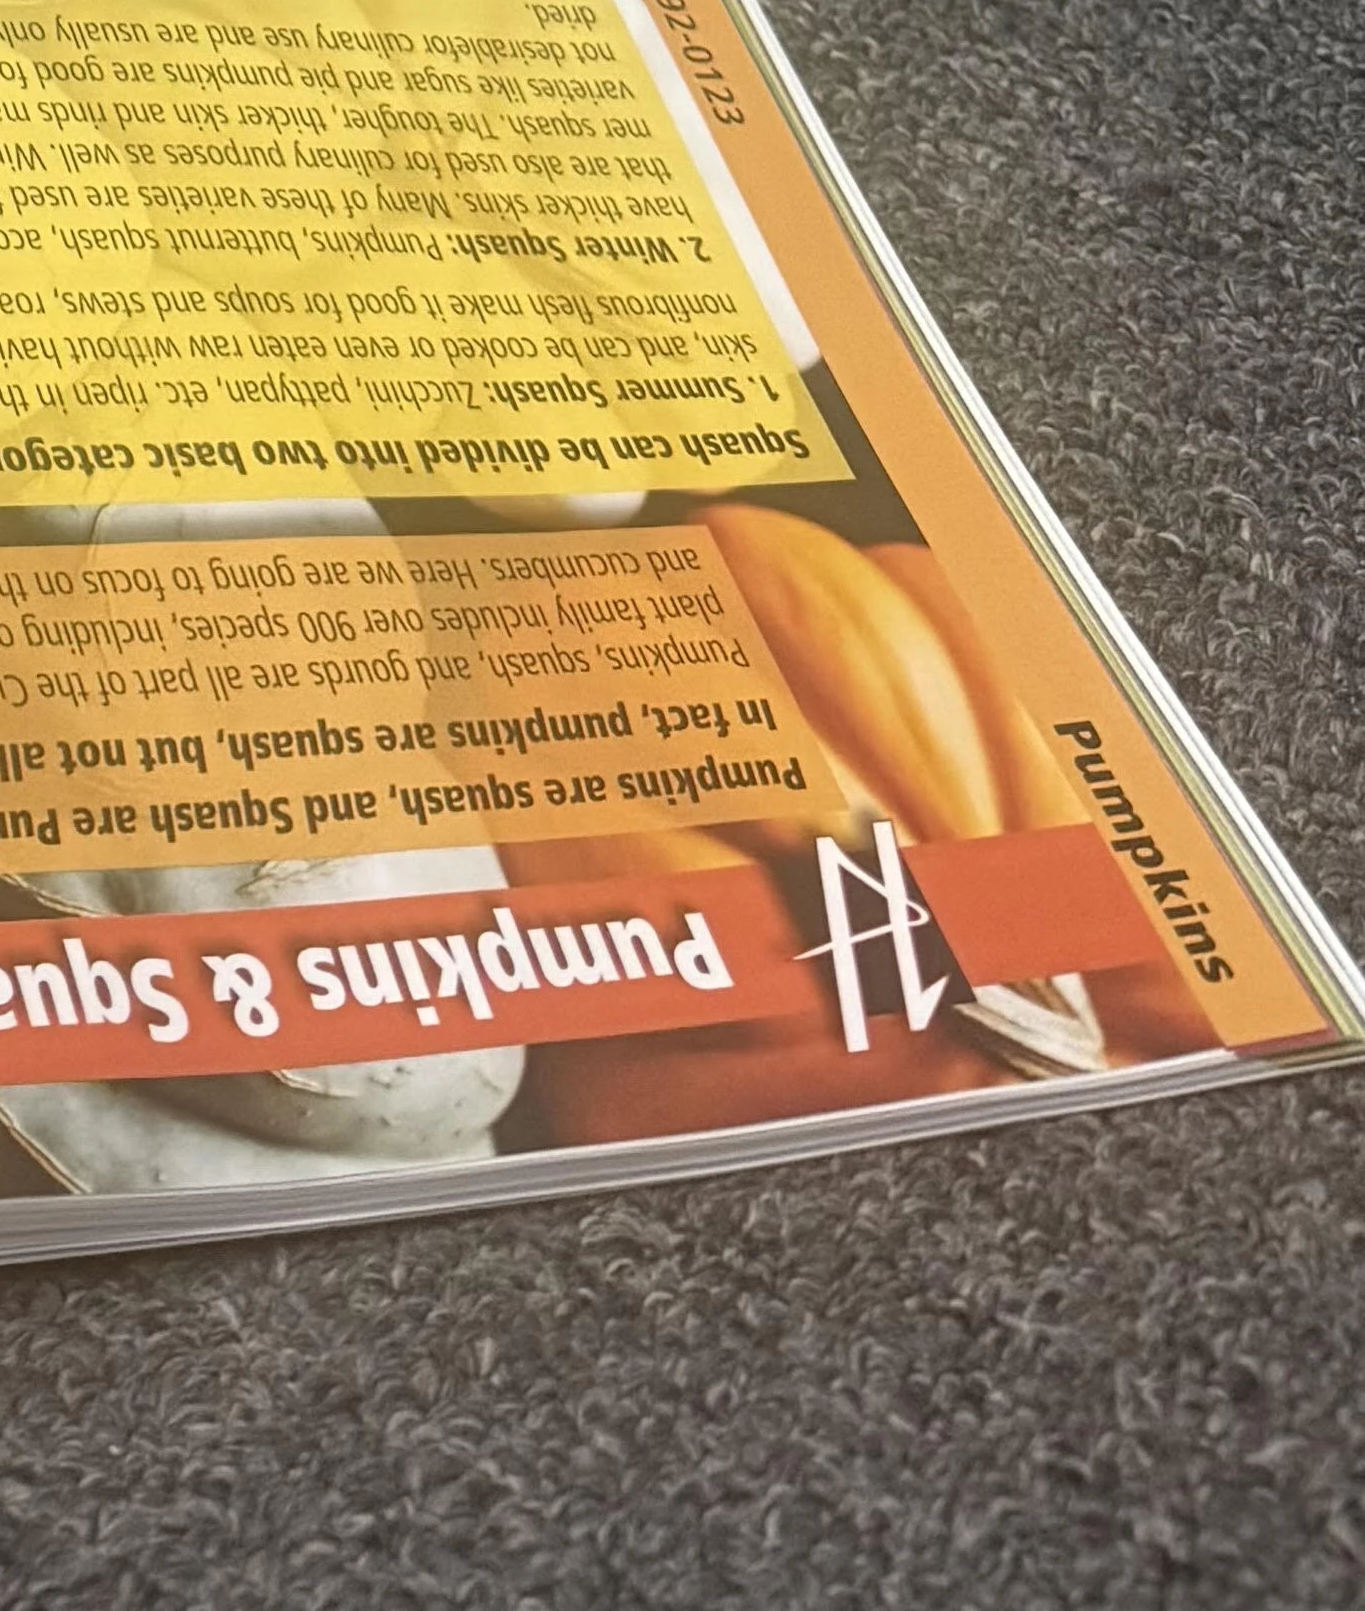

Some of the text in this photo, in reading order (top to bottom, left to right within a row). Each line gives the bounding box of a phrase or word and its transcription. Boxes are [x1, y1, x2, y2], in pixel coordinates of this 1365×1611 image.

[35, 383, 68, 415] in
[72, 374, 149, 413] ripen
[155, 381, 209, 408] etc.
[216, 372, 351, 408] pattypan,
[355, 377, 481, 412] Zucchini,
[483, 373, 609, 412] Squash:
[615, 376, 745, 404] Summer
[747, 375, 779, 402] 1.
[143, 441, 247, 477] basic
[253, 440, 328, 470] two
[335, 440, 413, 474] into
[415, 439, 550, 474] divided
[557, 438, 610, 470] be
[610, 435, 673, 459] can
[679, 423, 810, 466] Squash
[307, 649, 409, 696] gourds
[478, 642, 591, 687] squash,
[595, 634, 750, 676] Pumpkins,
[36, 672, 89, 707] the
[96, 671, 127, 707] of
[132, 657, 199, 701] part
[206, 665, 243, 702] all
[250, 663, 300, 689] are
[415, 656, 471, 691] and
[447, 701, 633, 755] pumpkins
[641, 703, 730, 740] fact,
[736, 699, 778, 731] In
[136, 736, 207, 774] but
[217, 718, 364, 771] squash,
[375, 723, 437, 751] are
[57, 739, 126, 776] not
[544, 775, 607, 806] are
[617, 755, 807, 805] Pumpkins
[150, 789, 293, 843] Squash
[303, 791, 377, 834] and
[389, 774, 534, 826] squash,
[73, 805, 137, 835] are
[1055, 717, 1237, 987] Pumpkins
[295, 909, 735, 1025] Pumpkins
[203, 951, 283, 1039] &
